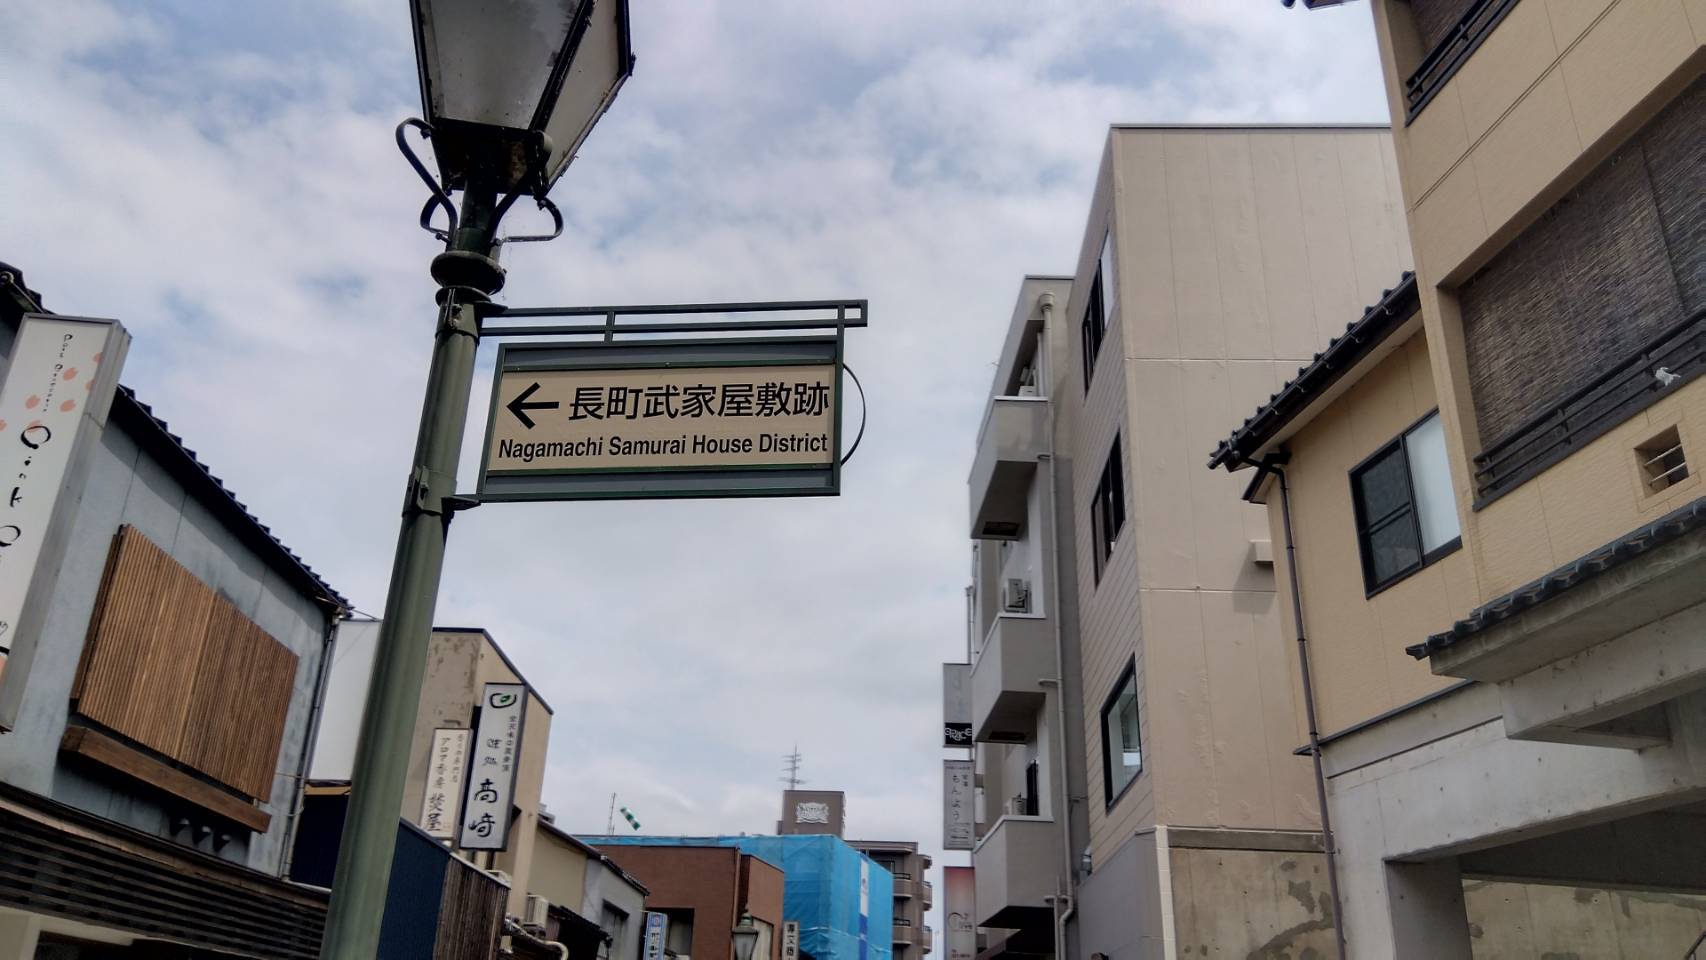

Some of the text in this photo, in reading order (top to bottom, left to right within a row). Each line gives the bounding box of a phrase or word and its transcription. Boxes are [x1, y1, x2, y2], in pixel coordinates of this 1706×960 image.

[568, 381, 830, 421] 長町武家屋敷跡
[498, 432, 828, 463] Nagamachi Samurai House District
